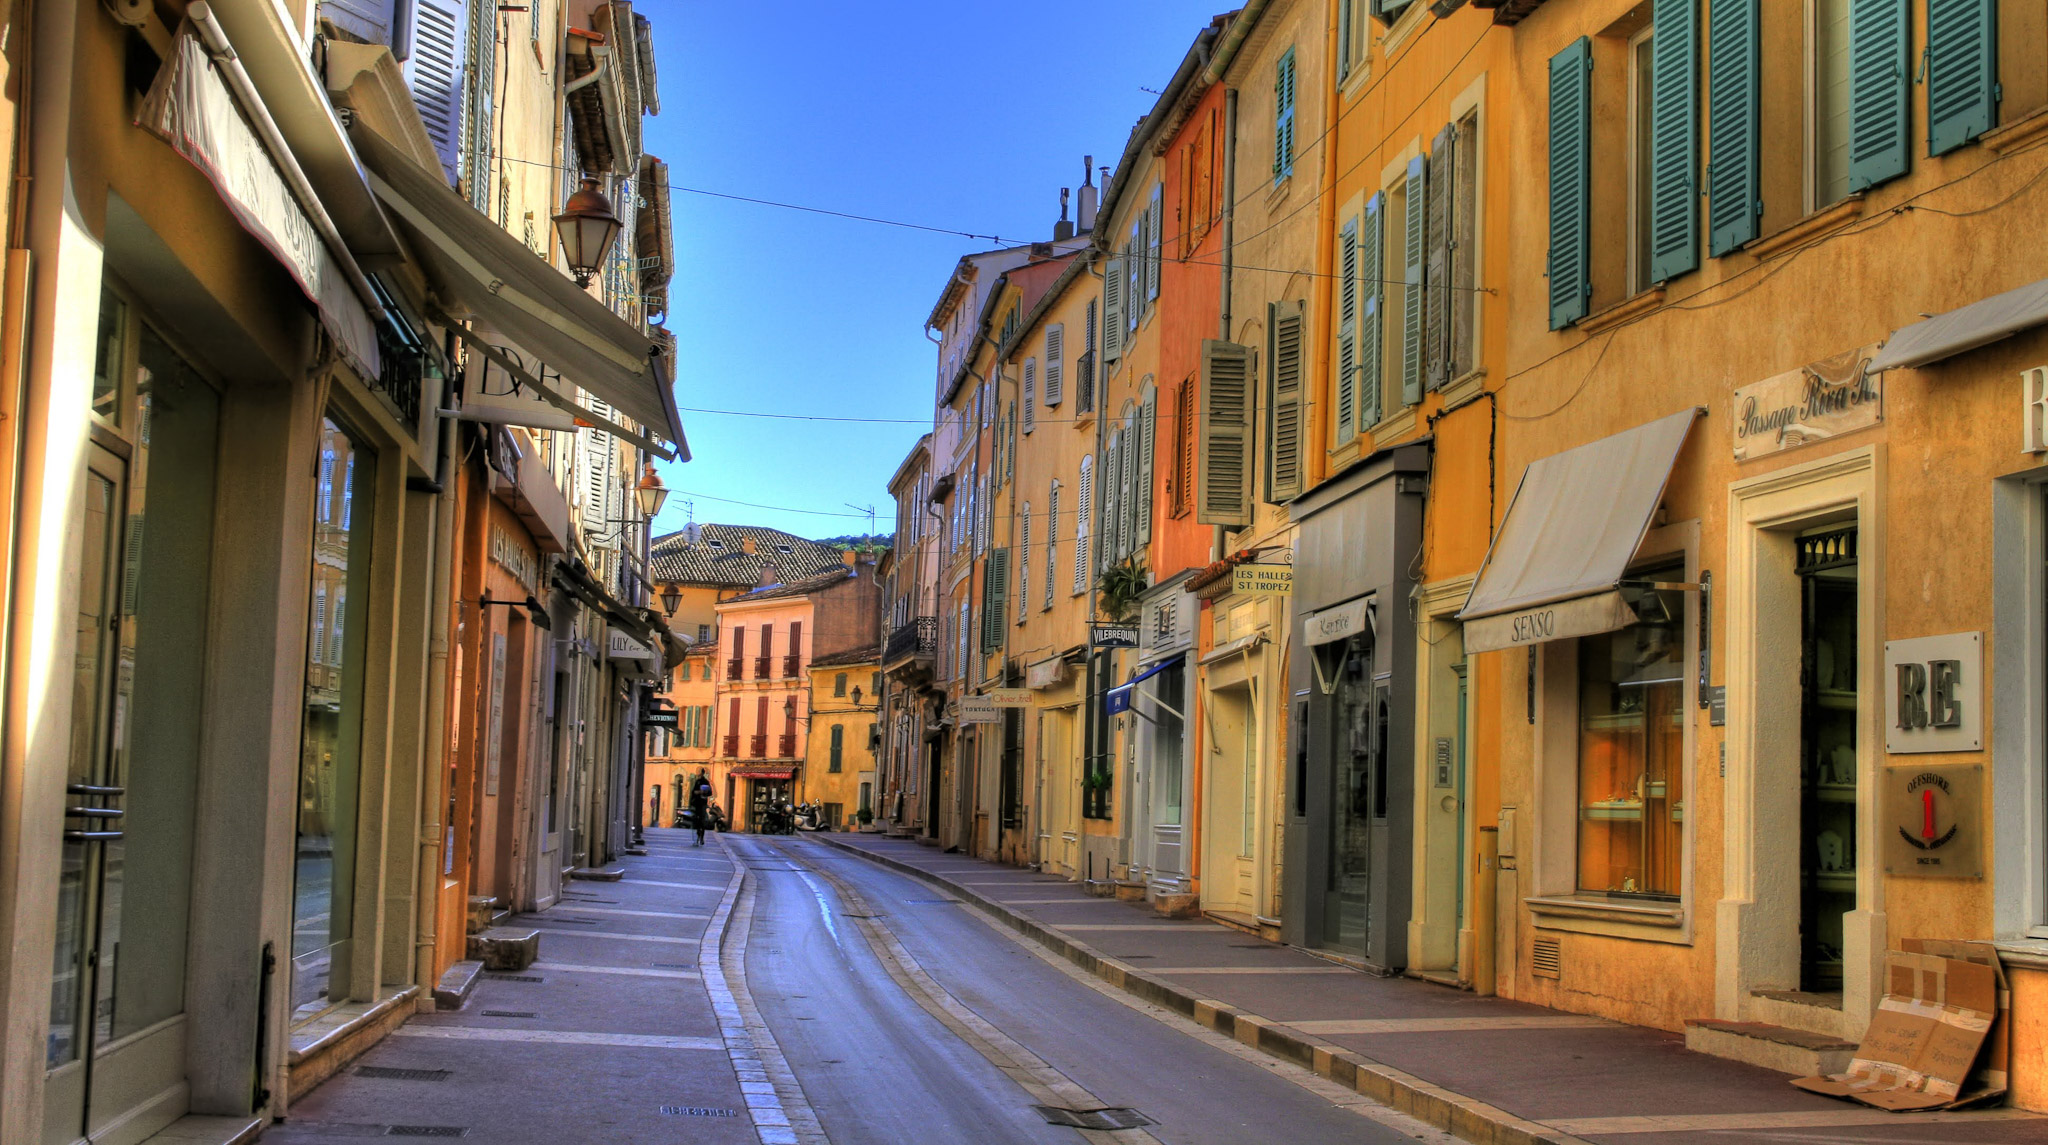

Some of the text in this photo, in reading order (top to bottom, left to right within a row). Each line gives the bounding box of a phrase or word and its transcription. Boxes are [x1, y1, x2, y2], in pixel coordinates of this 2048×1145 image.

[1738, 396, 1796, 444] Passage
[1800, 374, 1847, 421] Riva
[1235, 570, 1253, 579] LES
[1255, 581, 1291, 591] TROPEZ
[1511, 610, 1554, 642] SENSO
[612, 637, 629, 651] LILY
[1093, 629, 1138, 645] VILEBREQUIN
[1895, 659, 1961, 729] RE
